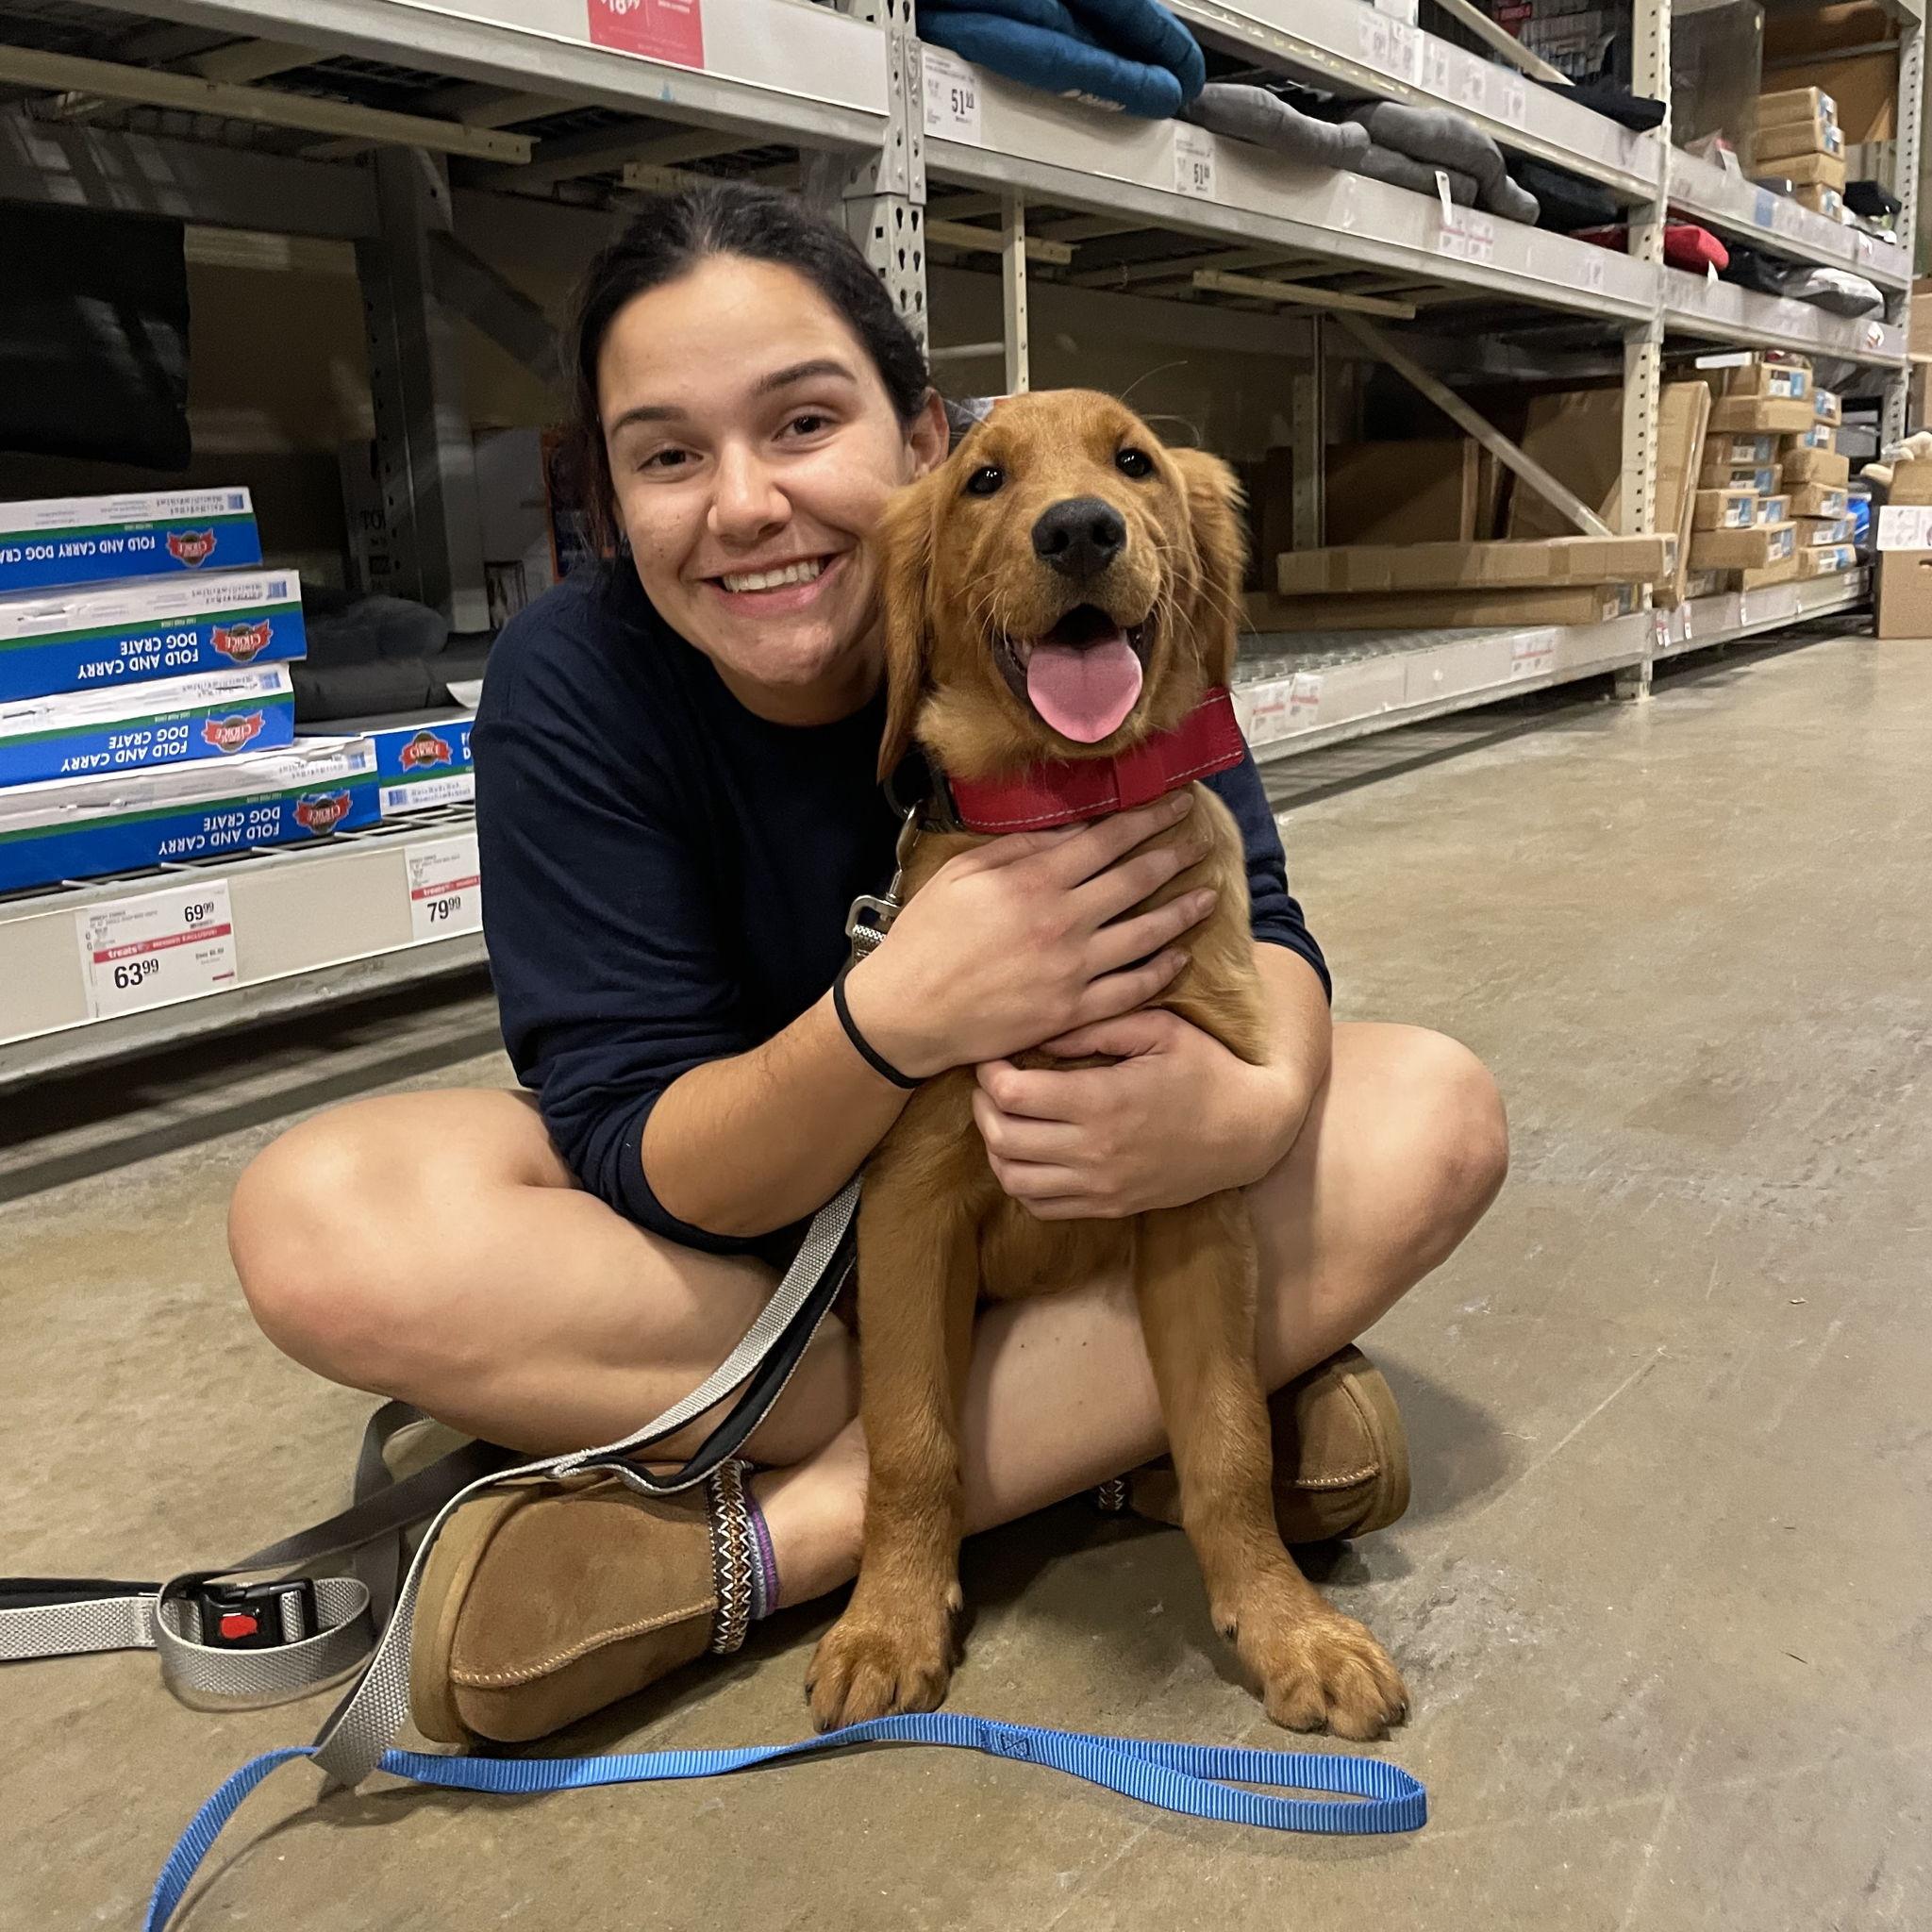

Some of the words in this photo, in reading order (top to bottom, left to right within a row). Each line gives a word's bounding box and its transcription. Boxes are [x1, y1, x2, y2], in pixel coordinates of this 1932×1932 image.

[58, 541, 95, 558] CARRY
[100, 540, 124, 554] AND
[128, 537, 155, 550] FOLD
[25, 545, 54, 560] DOG
[120, 637, 161, 656] CRATE
[166, 632, 197, 649] DOG
[225, 634, 261, 649] CHOICE
[129, 654, 159, 672] AND
[164, 648, 198, 665] FOLD
[77, 659, 125, 679] CARRY
[157, 724, 189, 741] DOG
[215, 723, 252, 739] CHOICE
[108, 730, 152, 750] CRATE
[115, 747, 147, 763] AND
[152, 741, 188, 757] FOLD
[60, 751, 110, 773] CARRY
[250, 807, 281, 824] DOG
[309, 804, 341, 819] CHOICE
[204, 812, 245, 832] CRATE
[211, 828, 241, 846] AND
[246, 823, 280, 840] FOLD
[158, 836, 206, 856] CARRY
[185, 902, 214, 923] 6999
[114, 958, 159, 990] 6399
